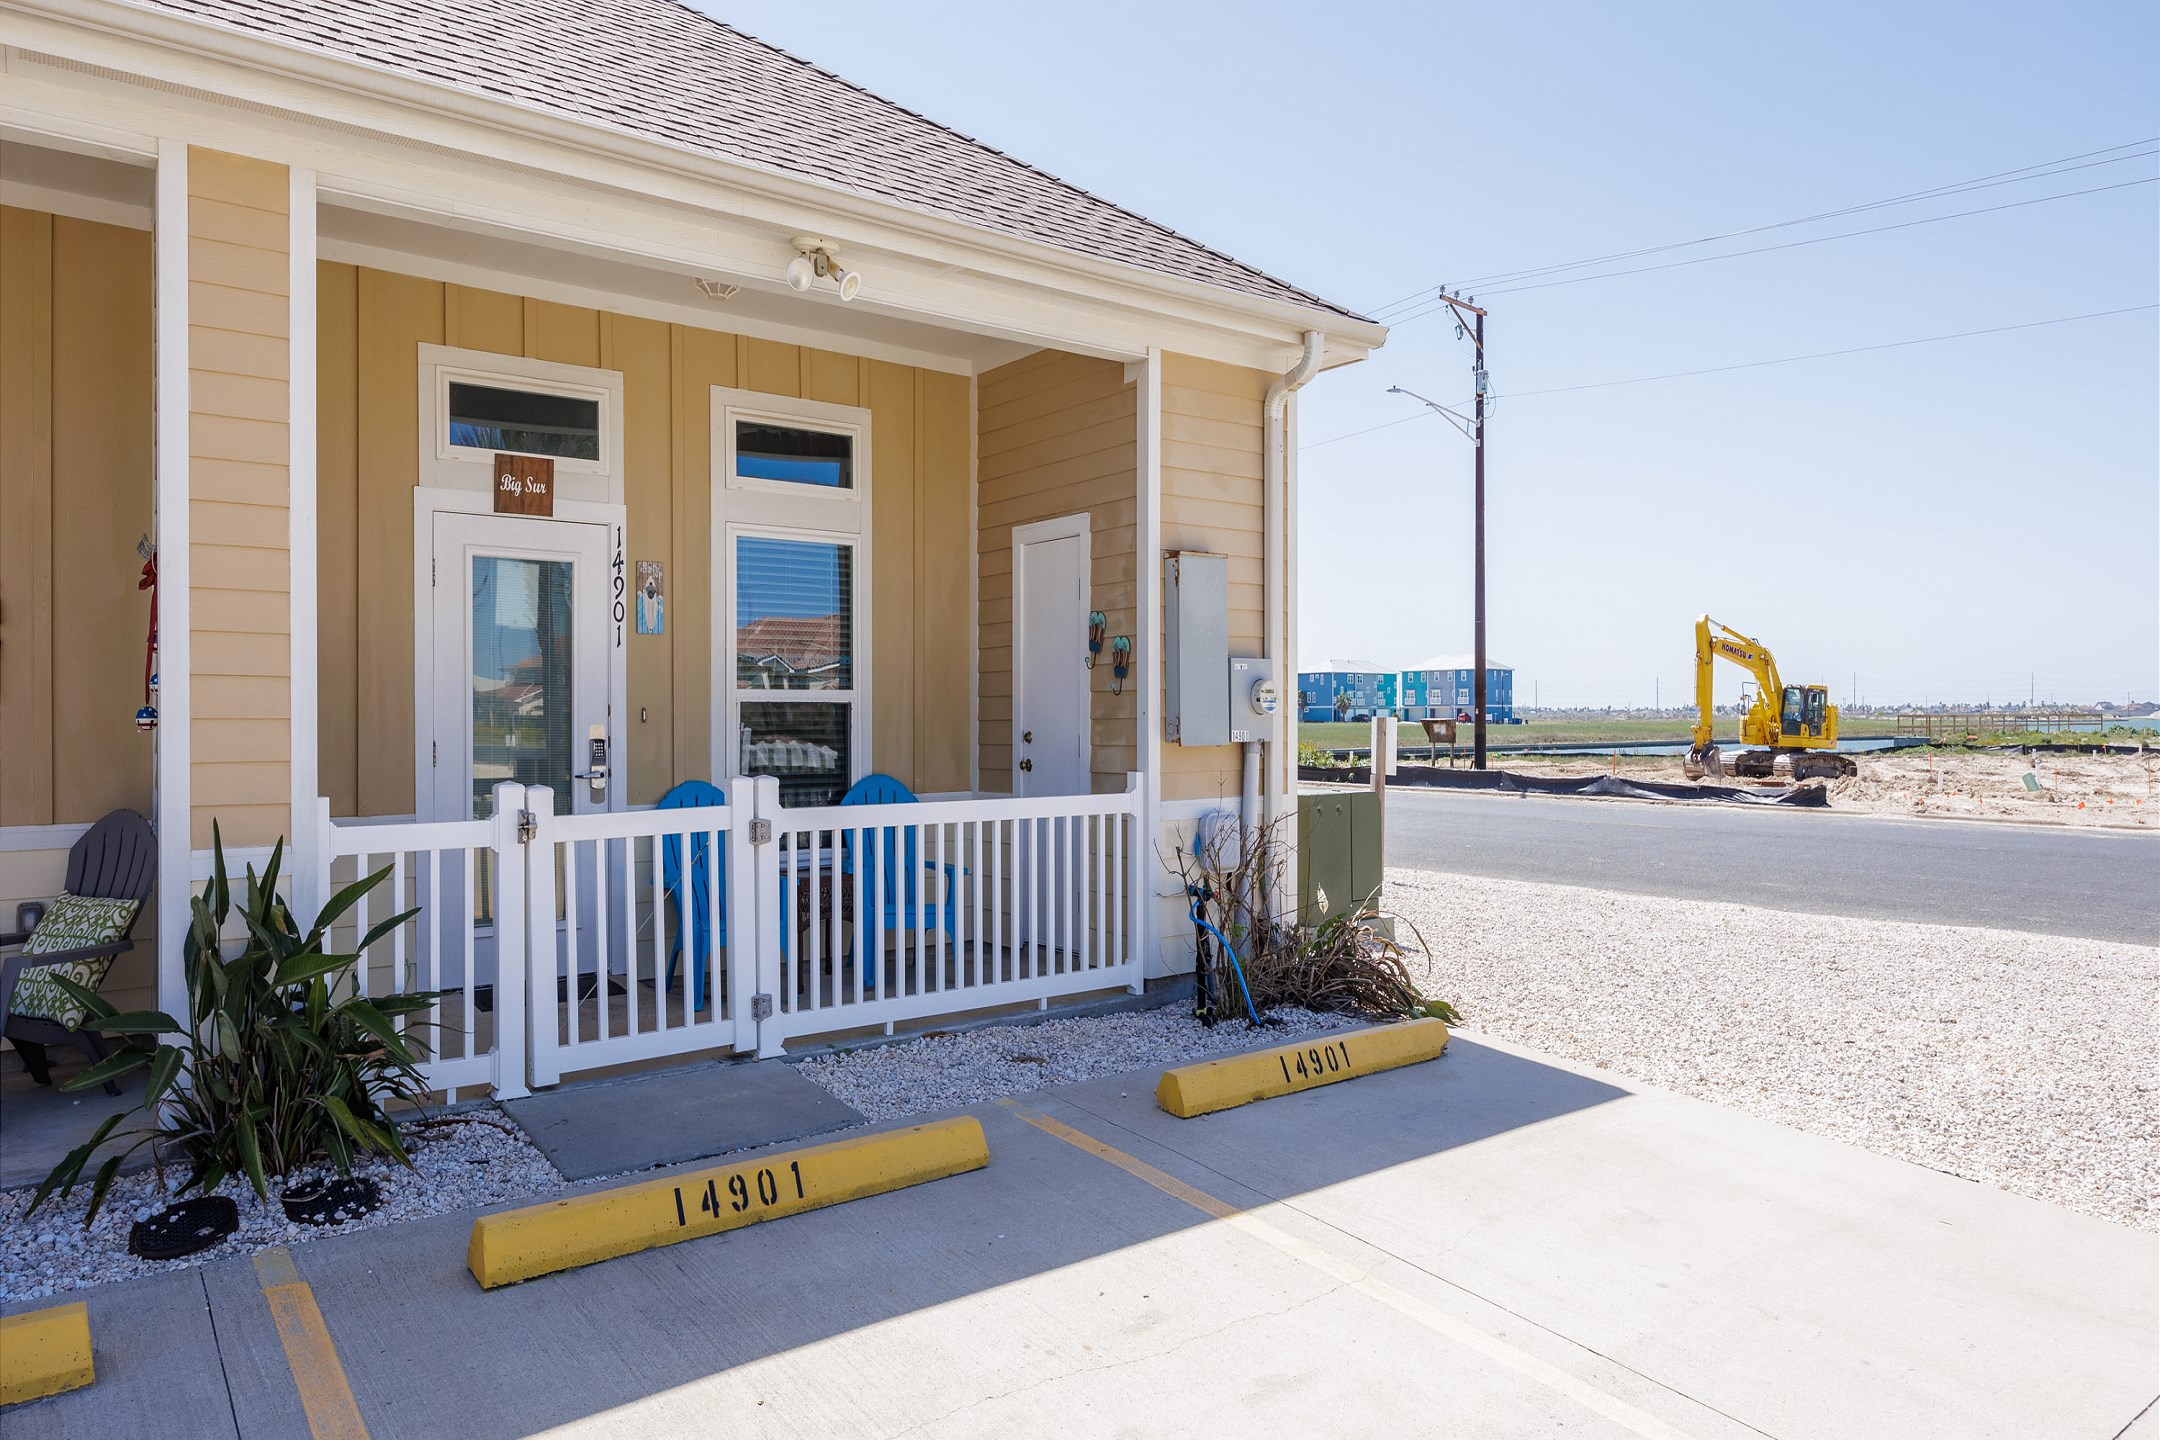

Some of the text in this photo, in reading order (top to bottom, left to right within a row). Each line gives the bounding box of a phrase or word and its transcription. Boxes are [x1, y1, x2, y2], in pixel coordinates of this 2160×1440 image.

[500, 474, 547, 497] Big Sur
[612, 525, 625, 648] 14901
[1721, 642, 1747, 659] KOMATSU
[1280, 1041, 1351, 1083] 14901
[674, 1161, 804, 1226] 14901
